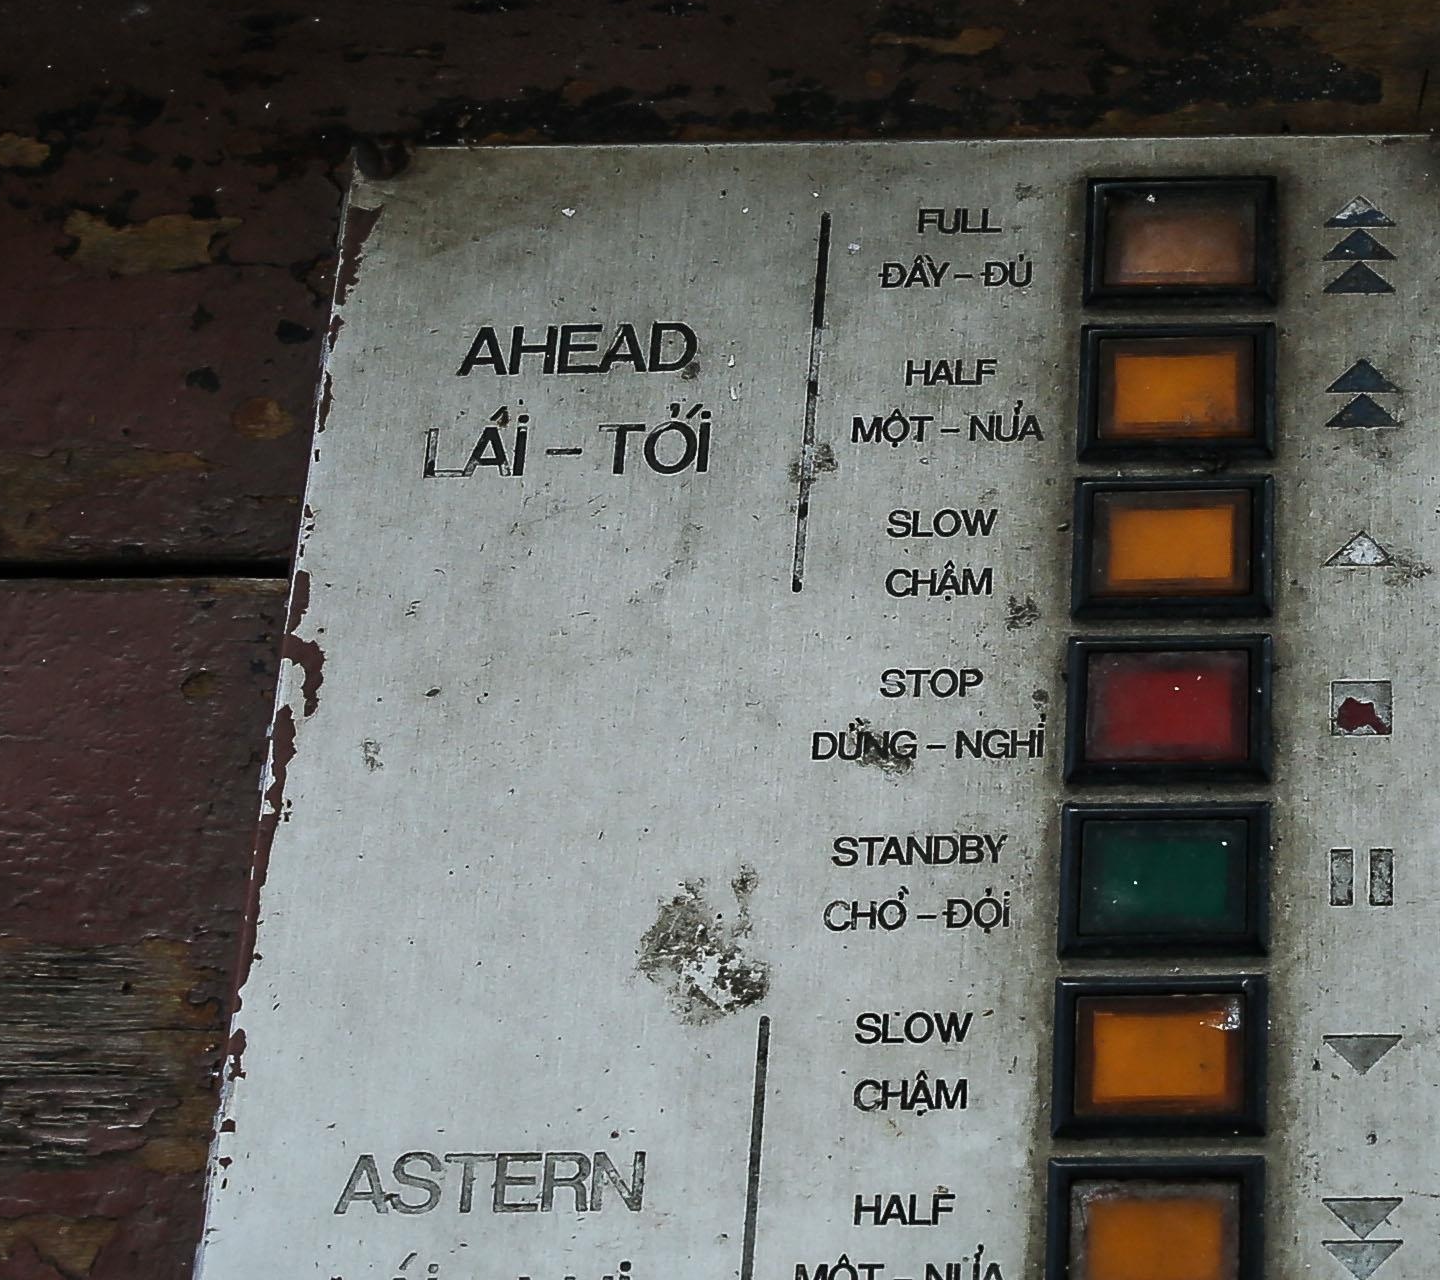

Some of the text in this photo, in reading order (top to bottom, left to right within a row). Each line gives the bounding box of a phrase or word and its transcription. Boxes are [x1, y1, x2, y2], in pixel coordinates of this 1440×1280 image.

[917, 207, 1002, 234] FULL
[456, 320, 698, 376] AHEAD
[905, 358, 998, 386] HALF
[886, 508, 998, 538] SLOW
[885, 560, 993, 601] CHẬM
[879, 668, 984, 698] STOP
[831, 833, 1008, 866] STANDBY
[854, 1011, 973, 1045] SLOW
[853, 1070, 968, 1116] CHẬM
[333, 1150, 647, 1215] ASTERN
[853, 1192, 956, 1226] HALF
